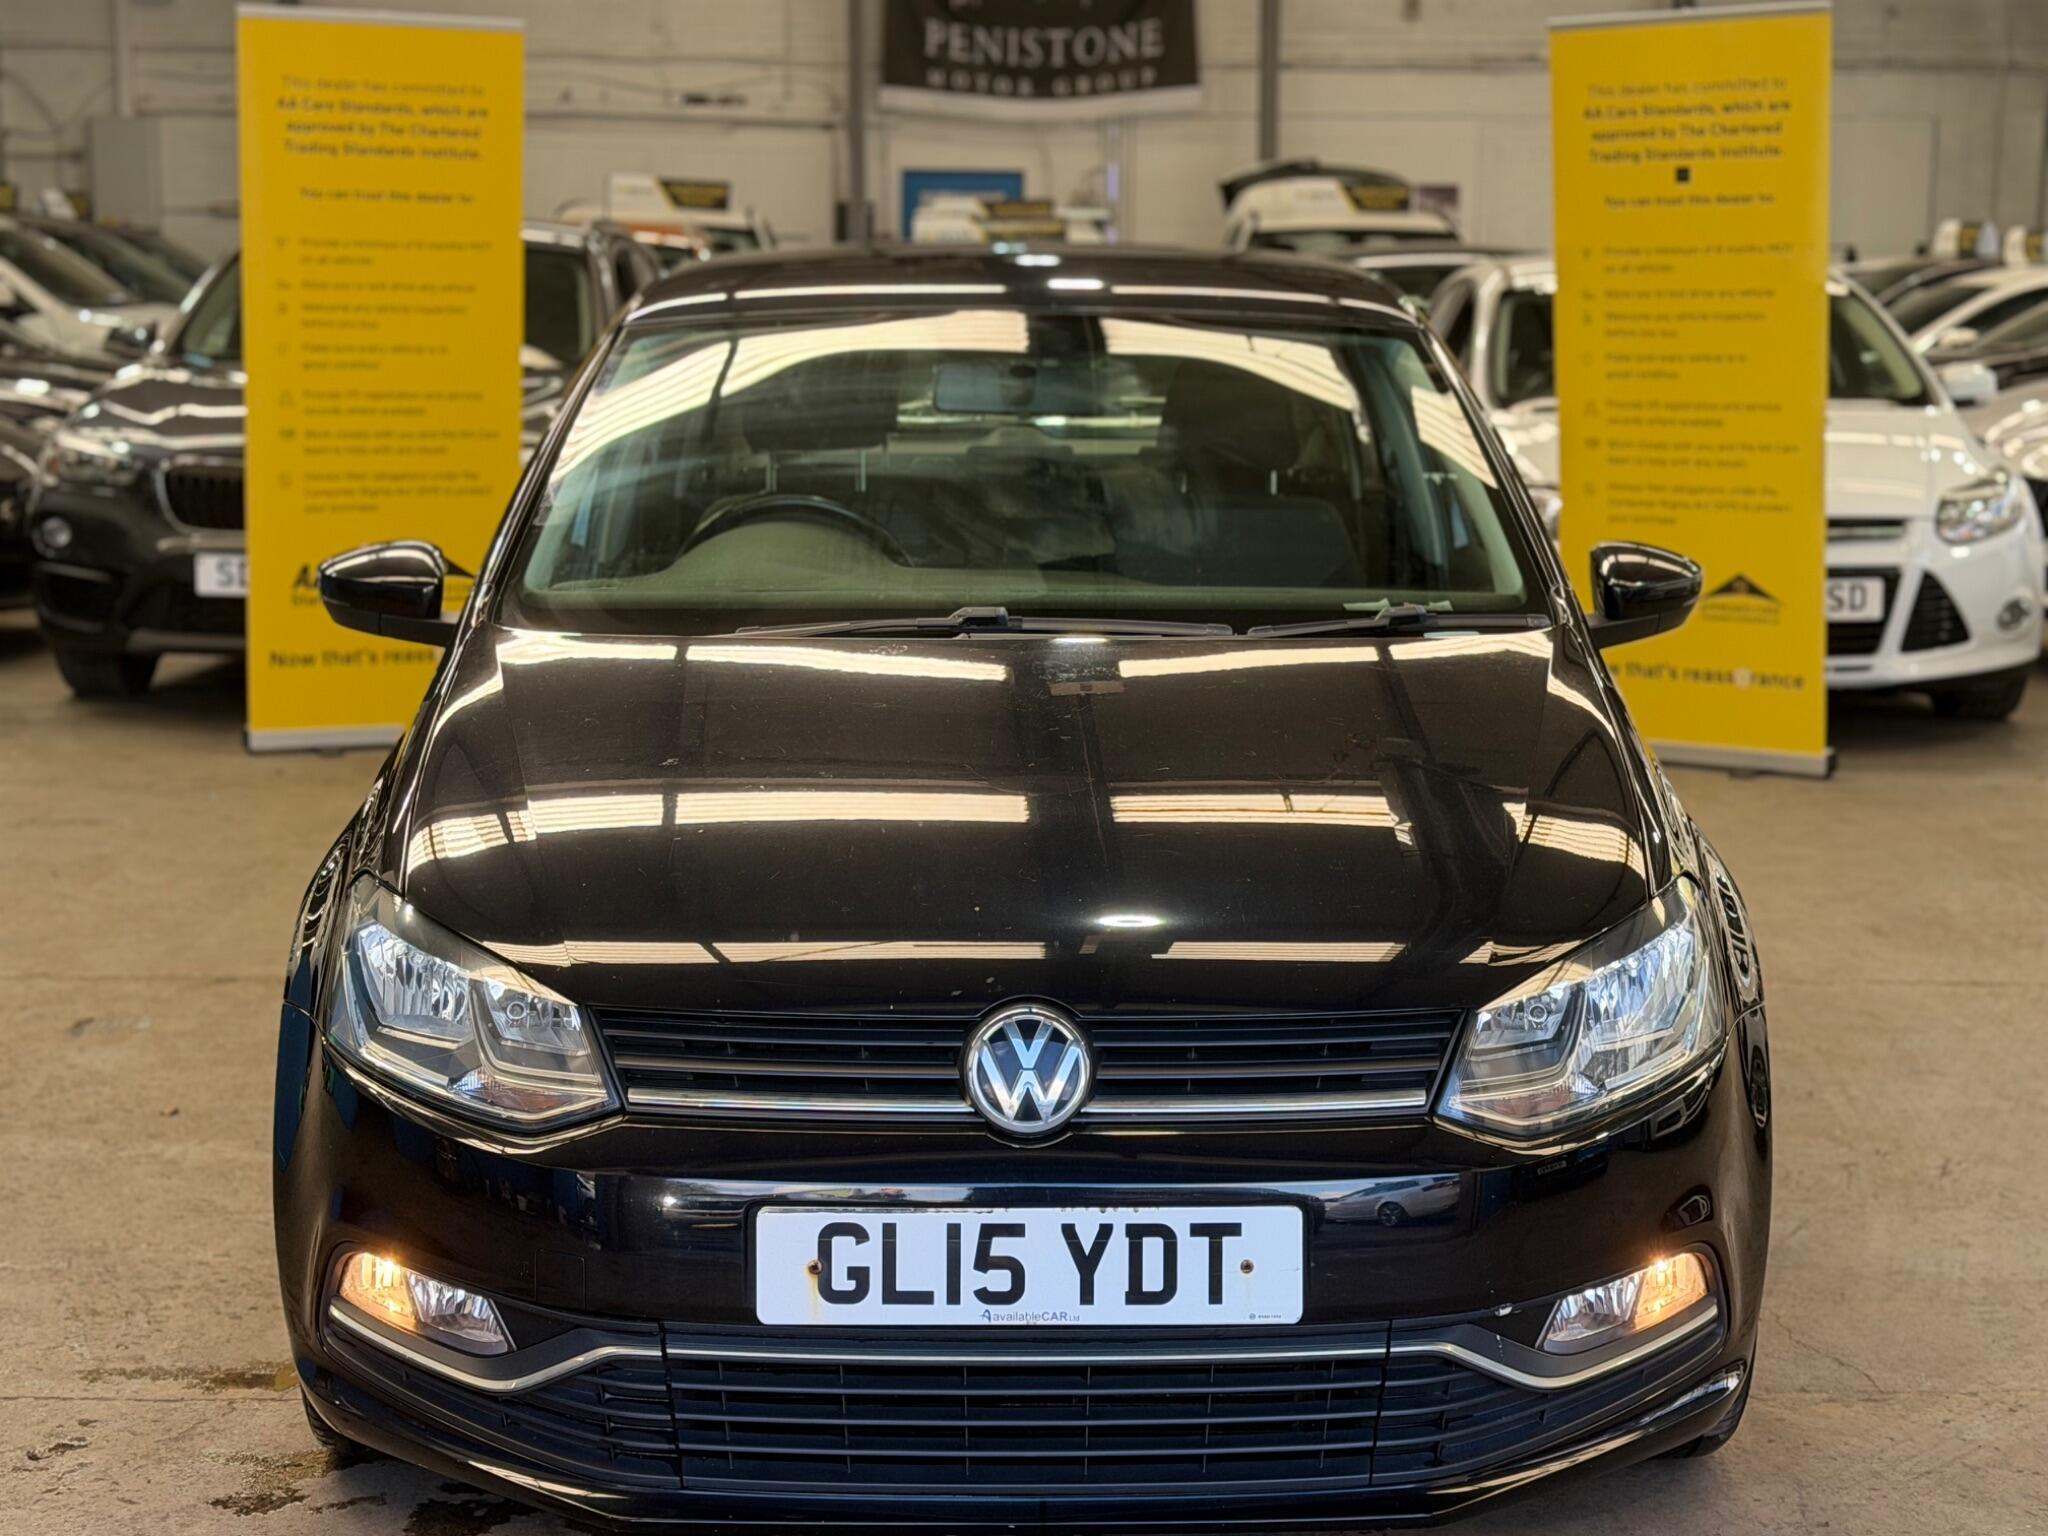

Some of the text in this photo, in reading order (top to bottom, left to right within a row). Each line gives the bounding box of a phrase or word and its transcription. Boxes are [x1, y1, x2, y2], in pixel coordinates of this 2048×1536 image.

[924, 15, 1165, 68] PENISTONE
[926, 67, 1034, 97] MOTOR
[1683, 664, 1806, 692] reassrance
[817, 1221, 1243, 1307] GL15 YDT
[992, 1311, 1068, 1322] availableCAR
